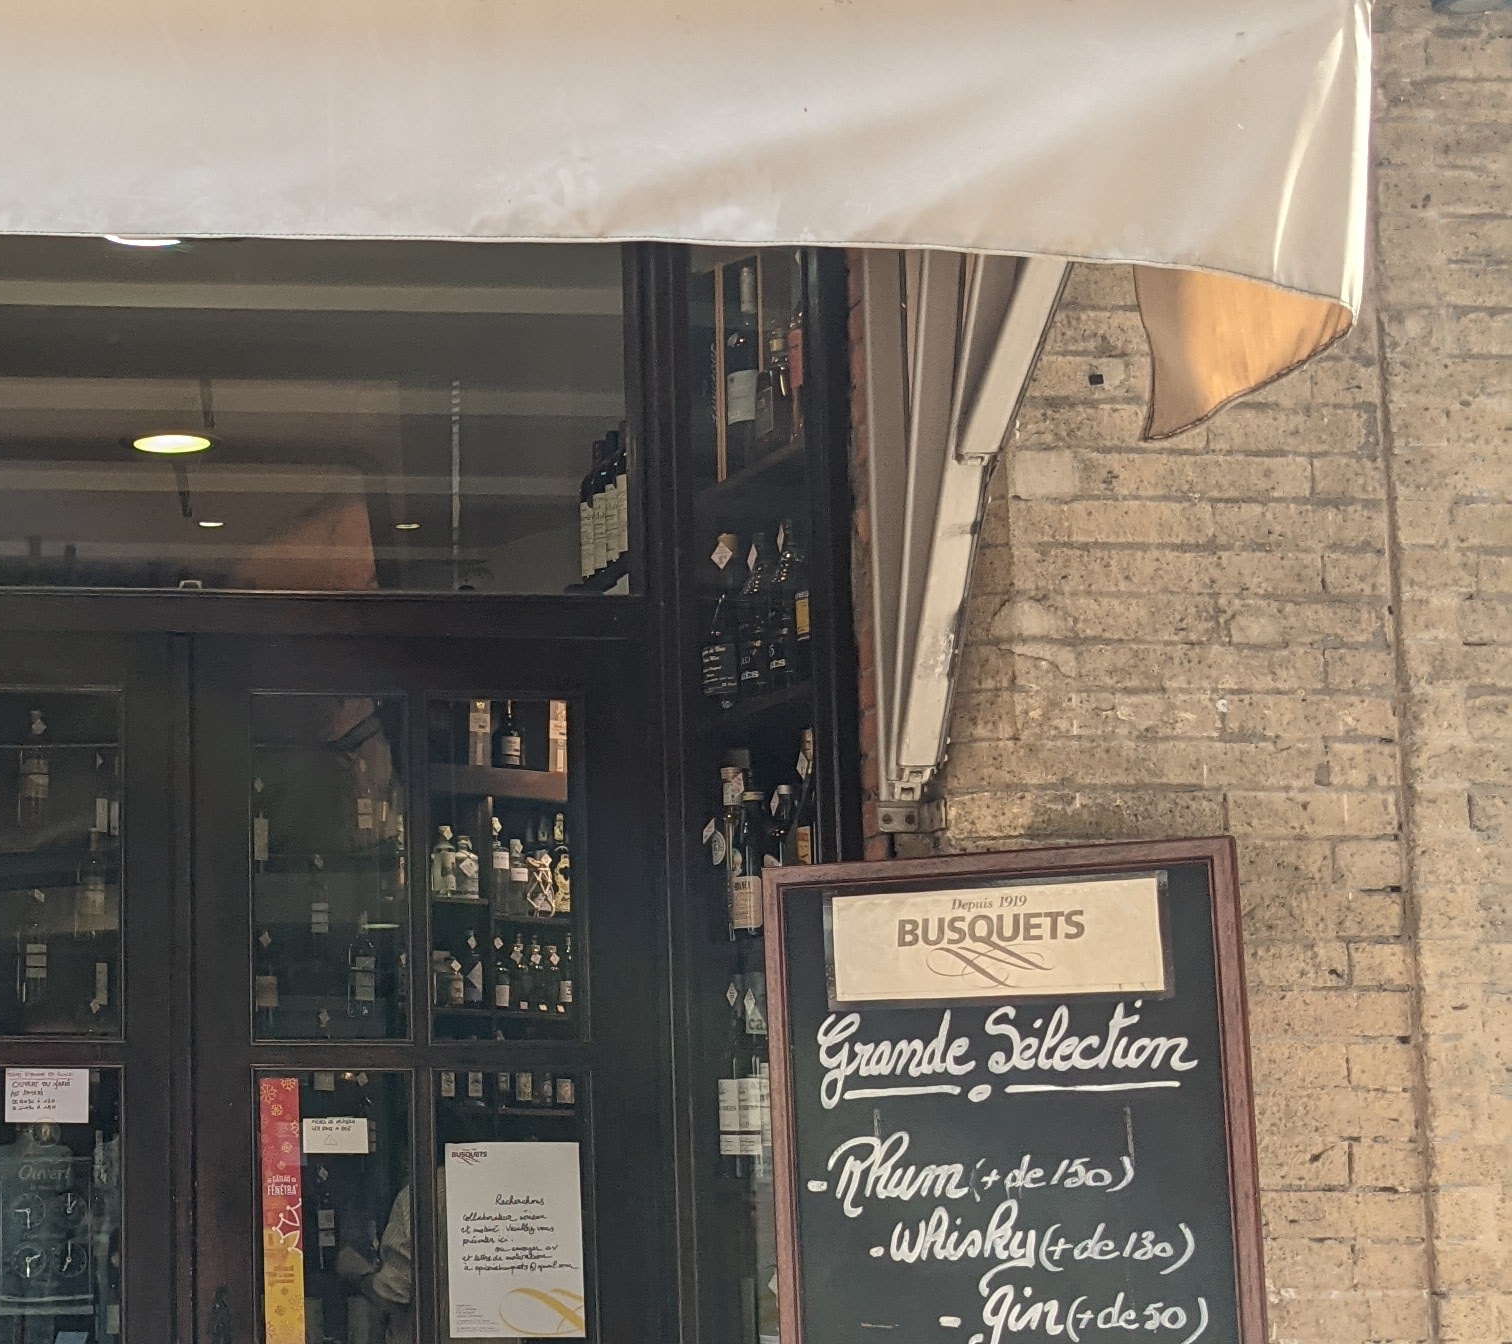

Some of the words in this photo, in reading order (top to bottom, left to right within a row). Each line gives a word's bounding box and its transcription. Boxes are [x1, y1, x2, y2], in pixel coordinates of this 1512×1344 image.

[951, 897, 994, 912] Depuis
[998, 894, 1028, 909] 1919
[897, 910, 1085, 947] BUSQUETS
[817, 1009, 976, 1109] Grande
[984, 999, 1199, 1075] Sélection
